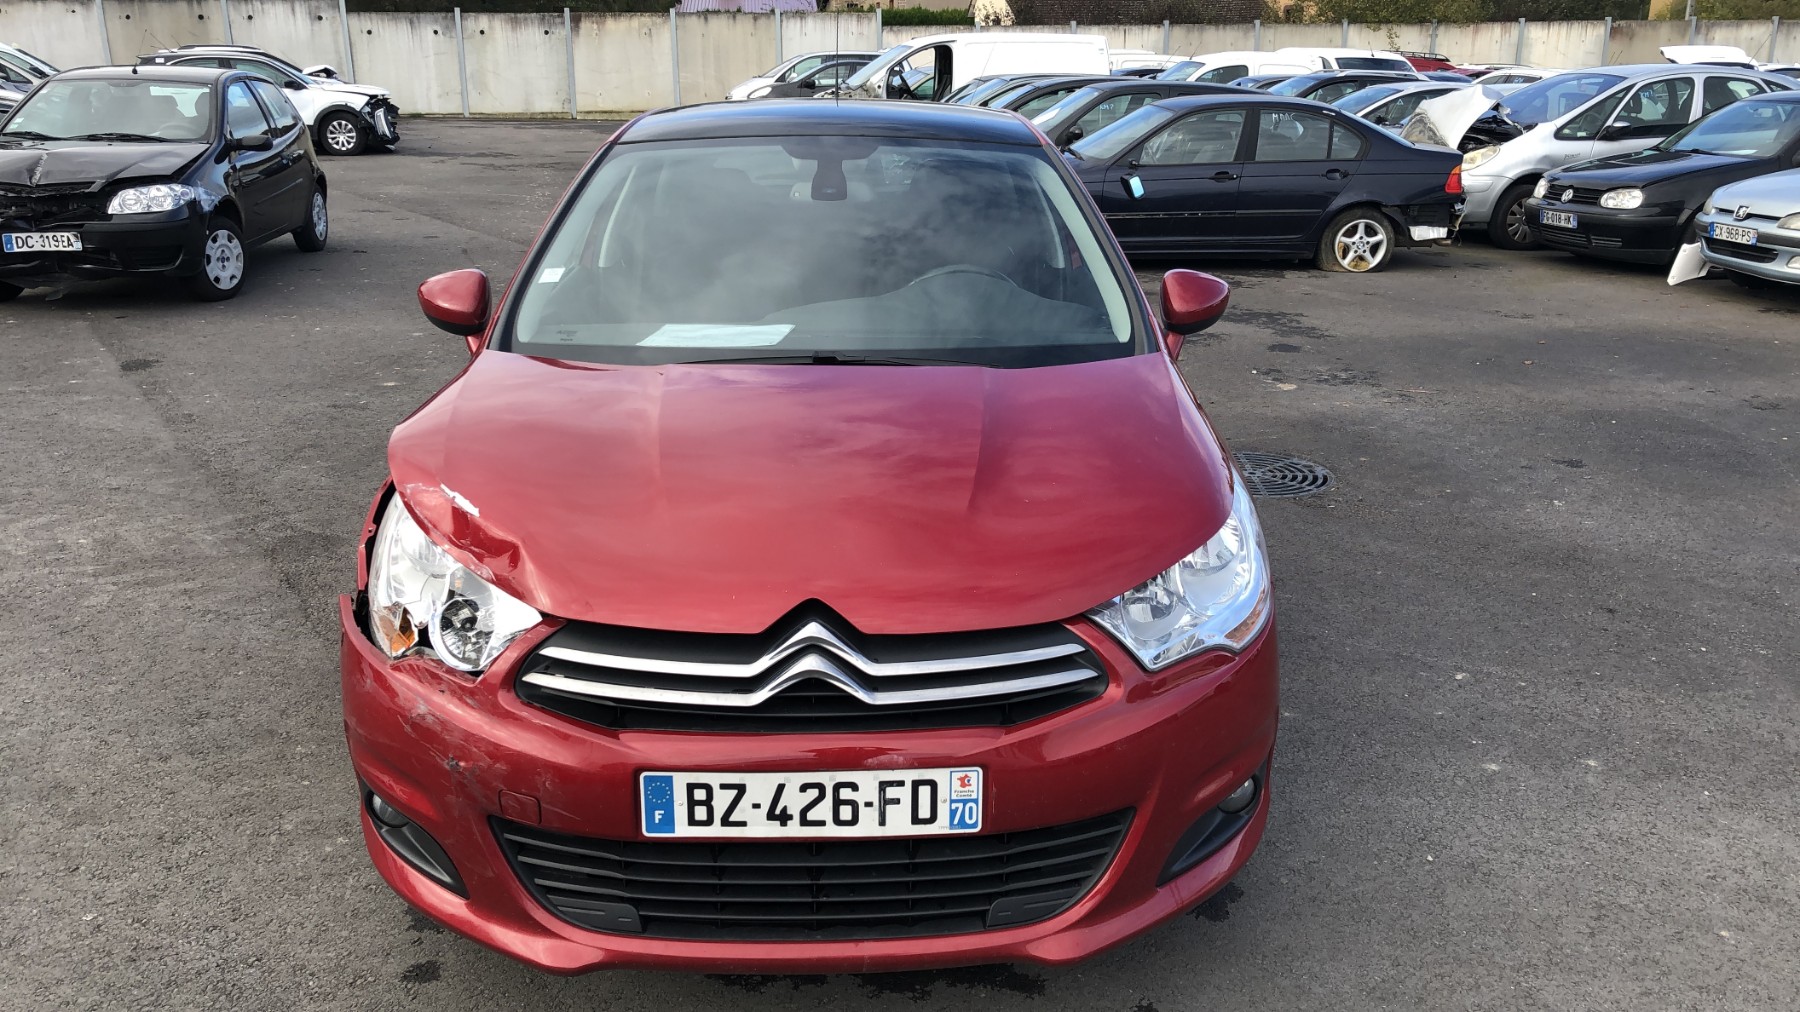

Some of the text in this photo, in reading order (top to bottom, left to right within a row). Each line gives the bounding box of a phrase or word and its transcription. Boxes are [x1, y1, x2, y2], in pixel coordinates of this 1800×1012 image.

[1714, 225, 1752, 243] CX-968-PS
[685, 779, 939, 828] BZ-426-FD
[951, 802, 977, 825] 70
[654, 810, 665, 824] F
